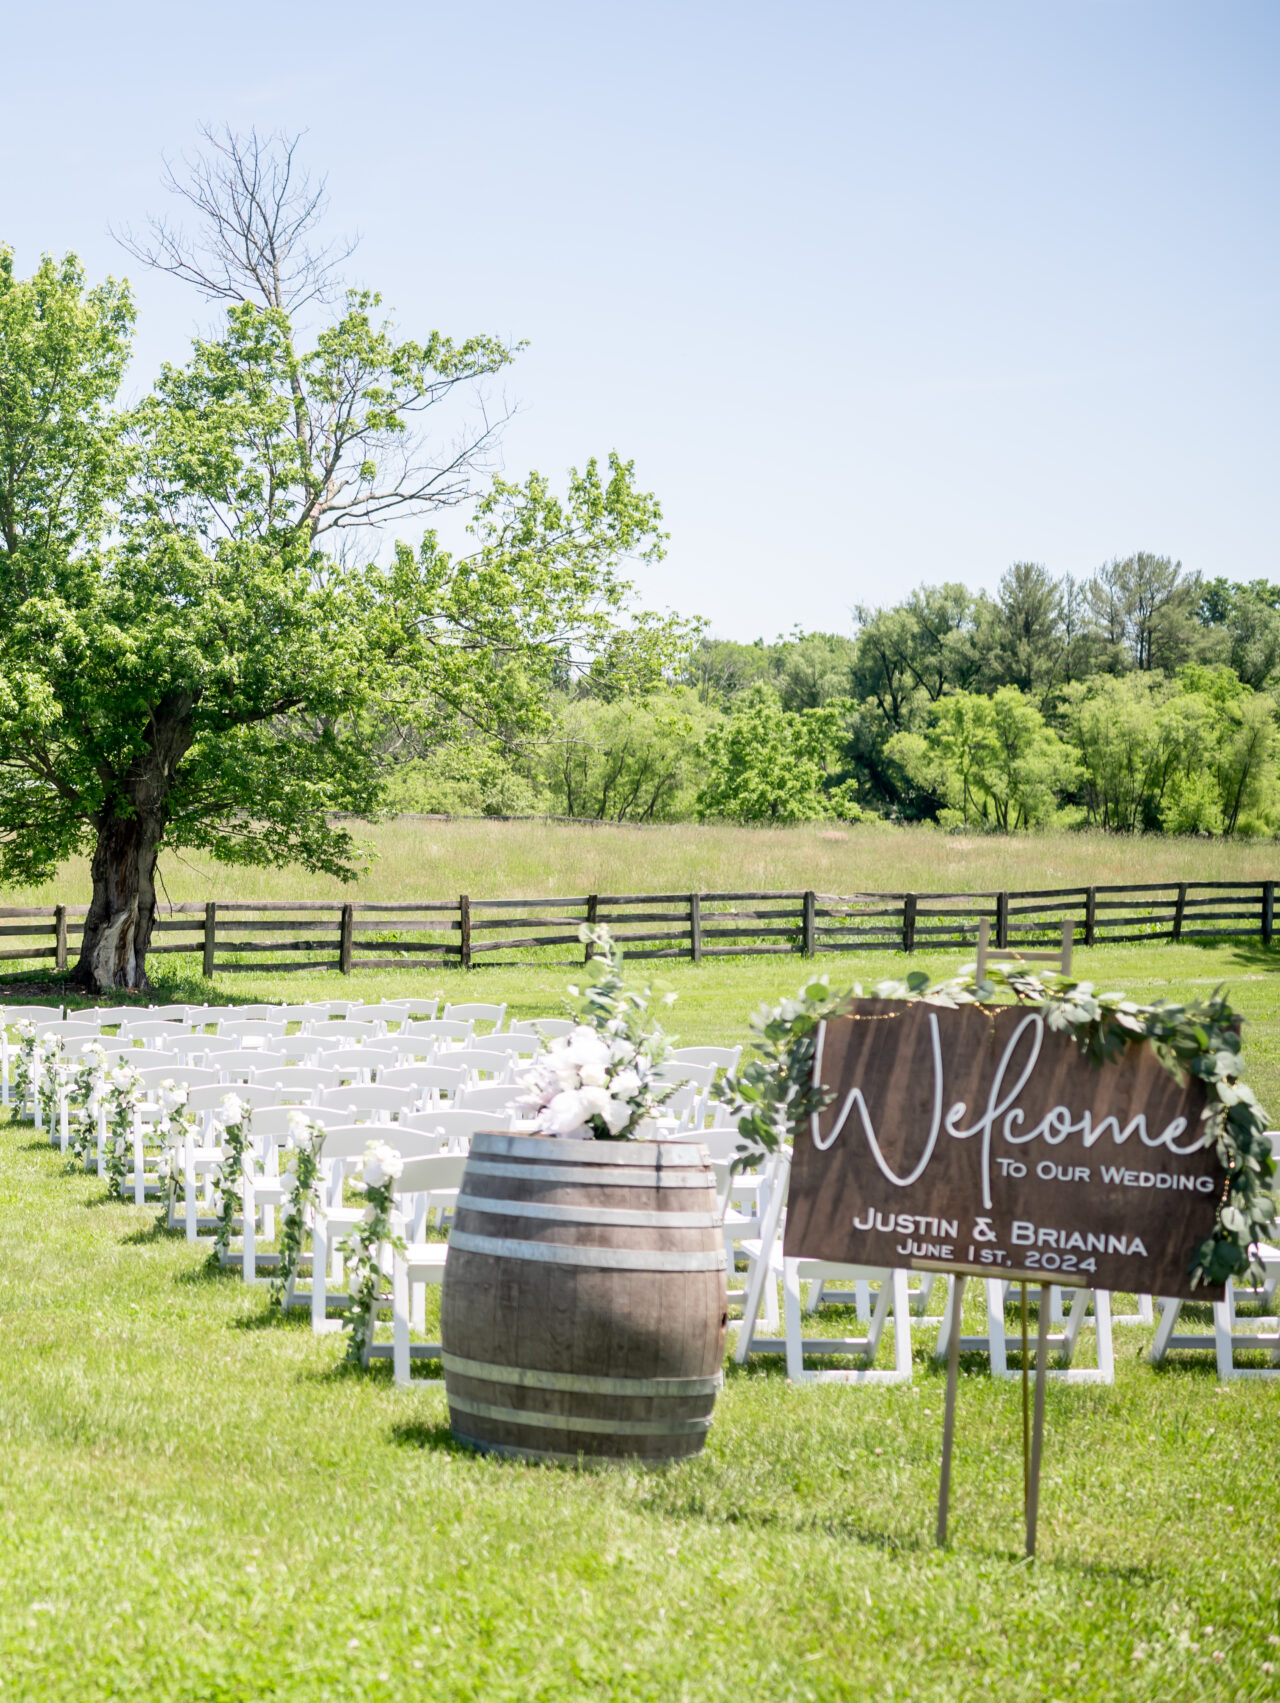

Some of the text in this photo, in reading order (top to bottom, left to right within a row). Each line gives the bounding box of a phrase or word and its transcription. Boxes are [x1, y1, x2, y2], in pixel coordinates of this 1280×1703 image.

[811, 1012, 1207, 1209] Welcome
[973, 1218, 998, 1244] &
[1025, 1250, 1098, 1275] 2024
